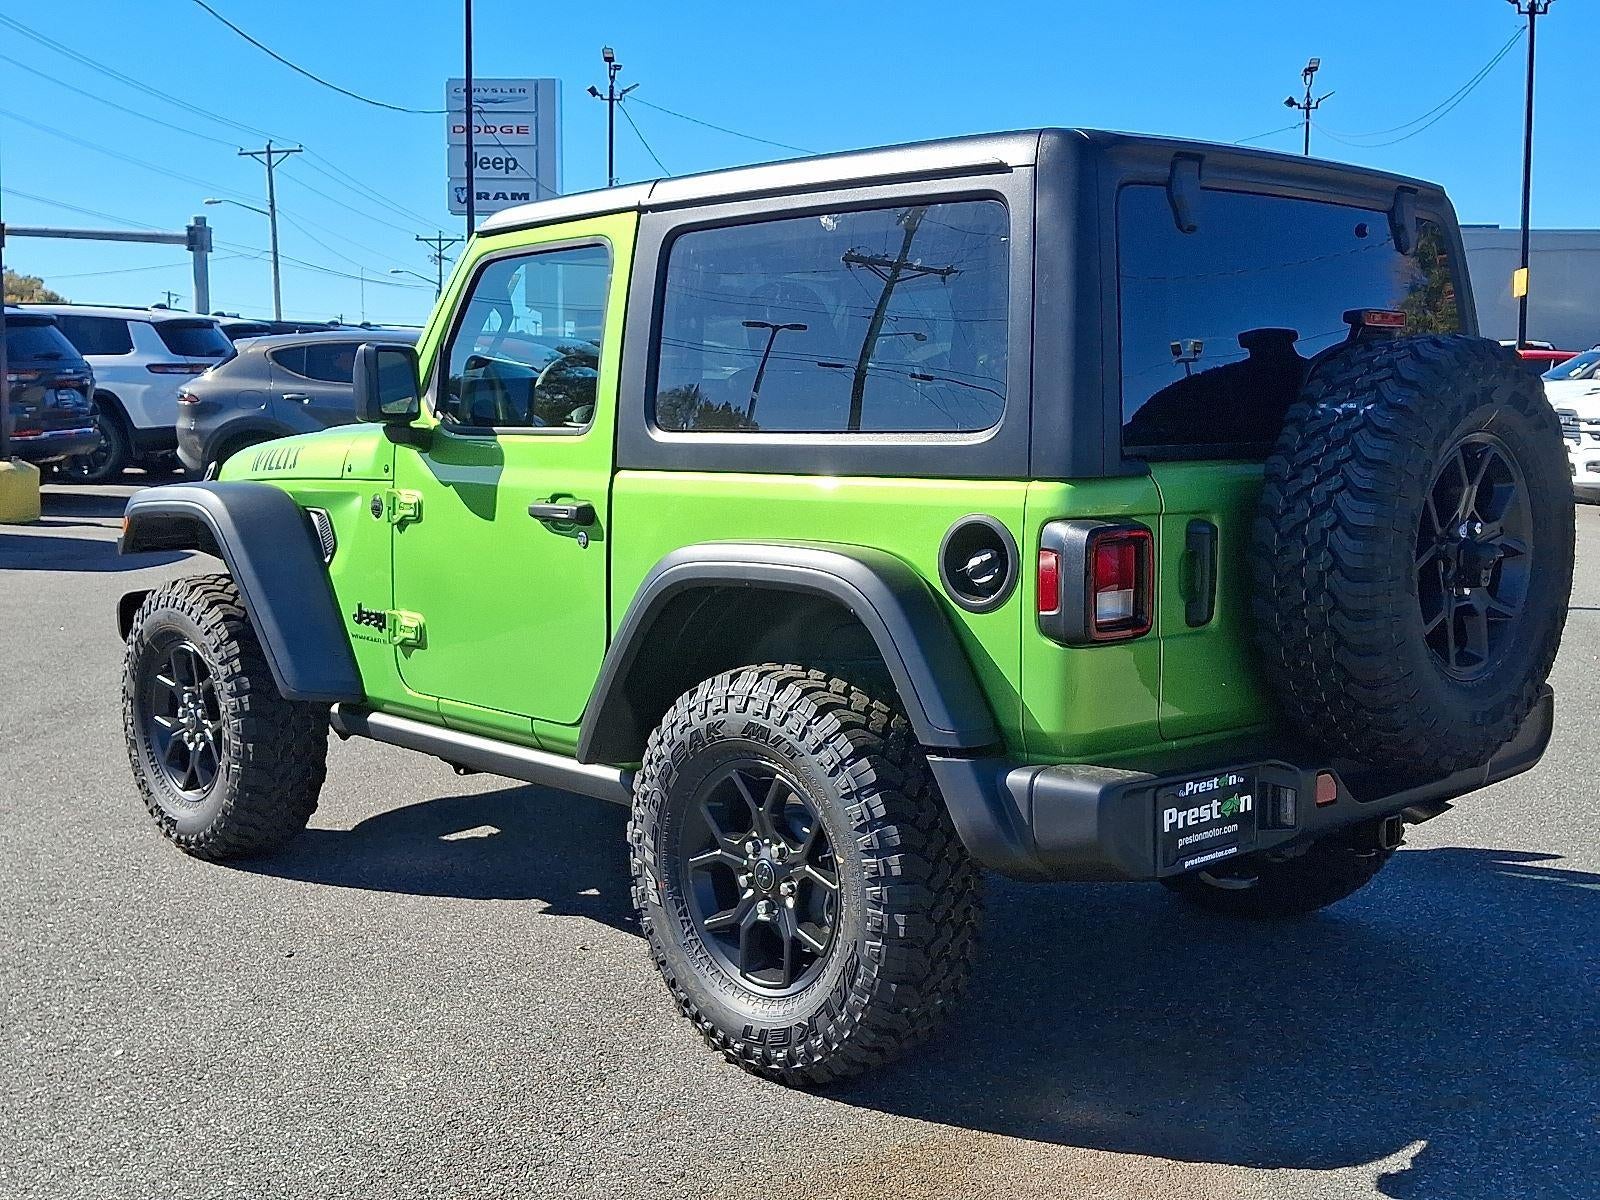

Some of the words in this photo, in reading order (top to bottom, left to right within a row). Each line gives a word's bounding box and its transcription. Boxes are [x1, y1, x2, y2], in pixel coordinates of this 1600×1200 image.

[475, 191, 530, 201] RAM
[352, 602, 387, 633] Jeep
[643, 718, 727, 908] WILDPEAK
[1163, 793, 1252, 833] Preston
[1178, 823, 1239, 849] prestonmotor.com
[740, 938, 861, 1047] FALKEN
